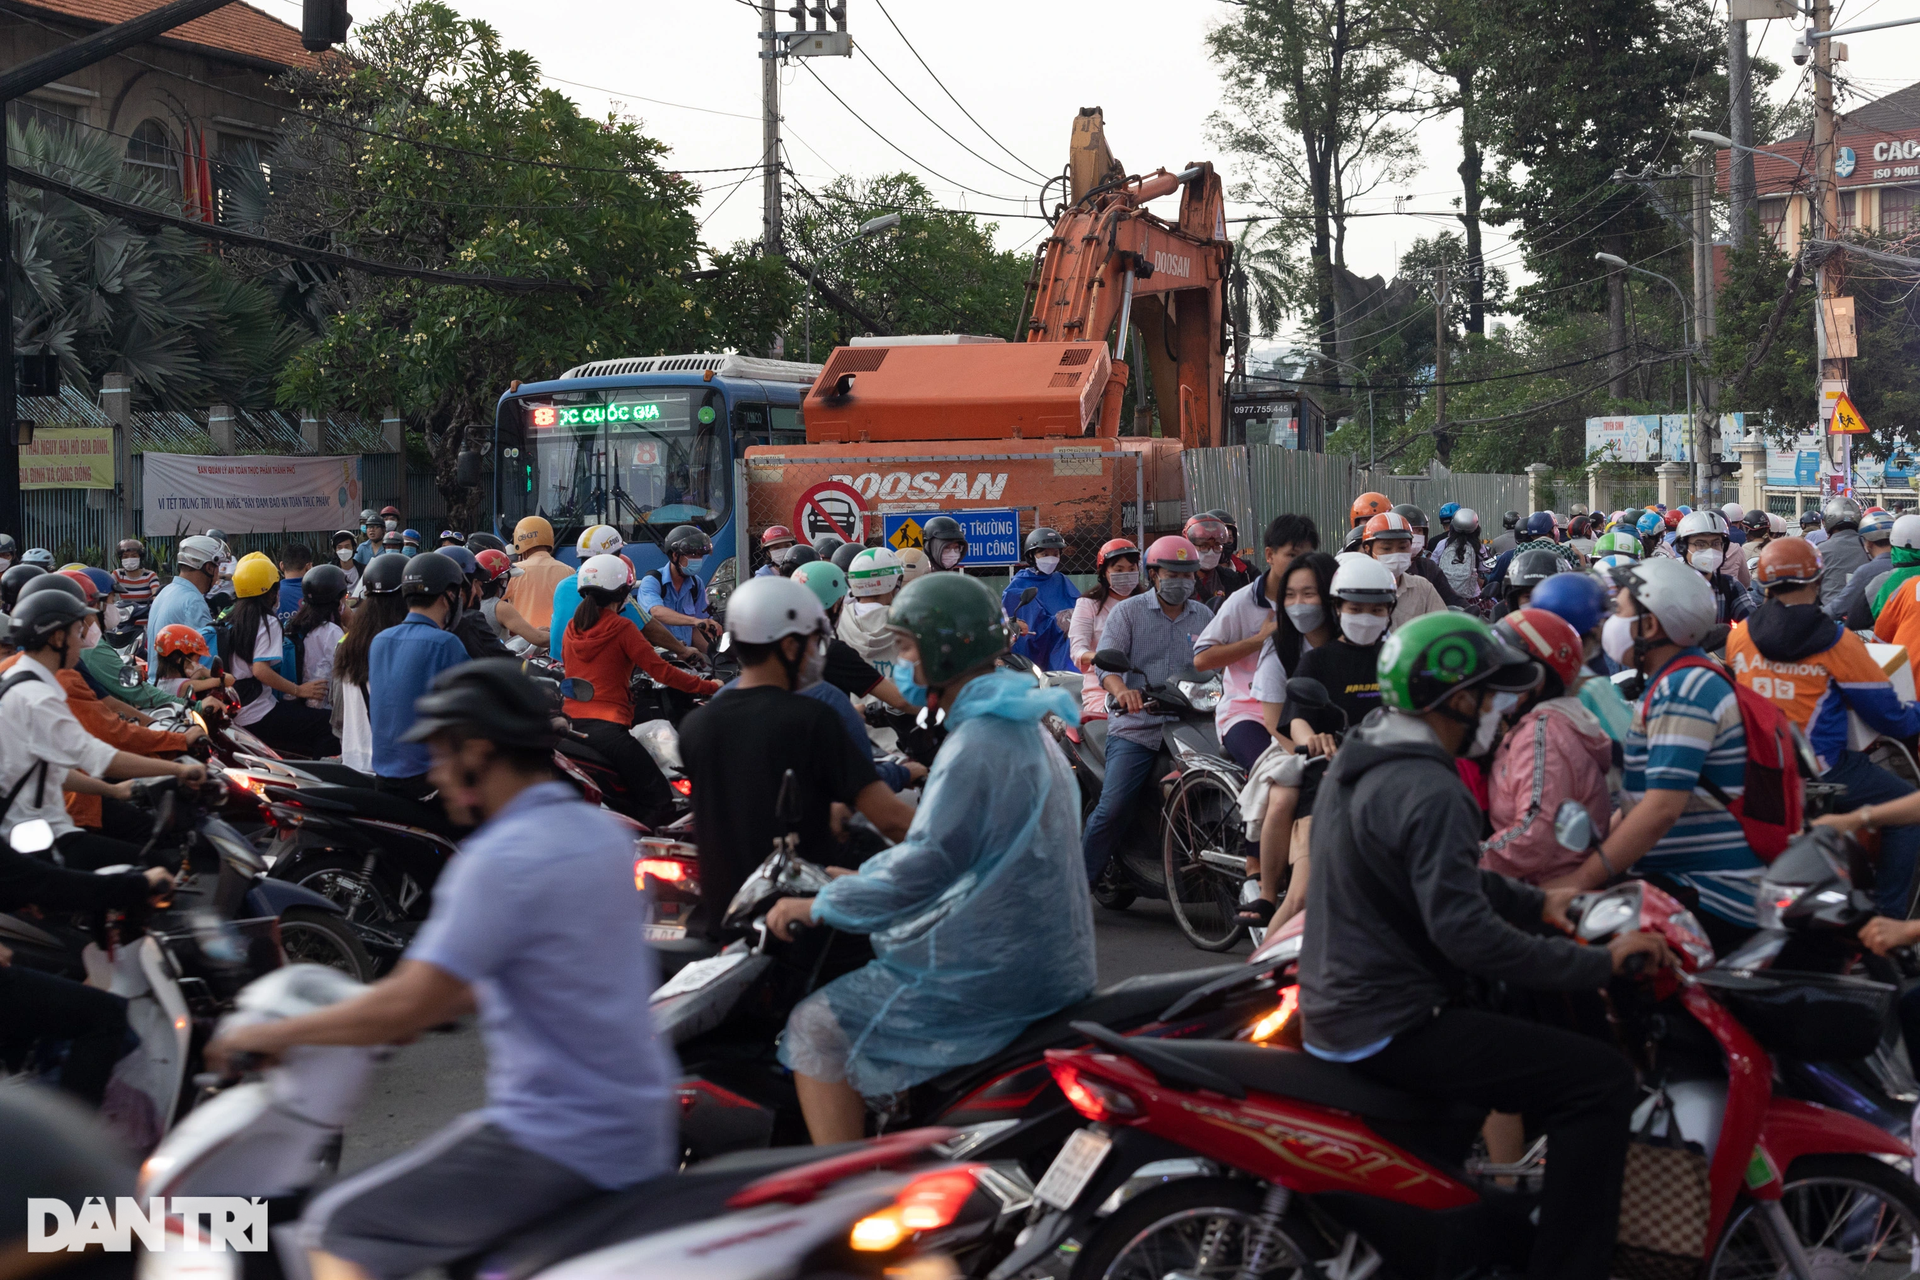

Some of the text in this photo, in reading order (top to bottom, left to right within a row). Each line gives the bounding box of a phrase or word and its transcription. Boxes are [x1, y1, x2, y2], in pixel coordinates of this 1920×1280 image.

[1873, 168, 1891, 179] ISO
[1154, 251, 1190, 278] DOOSAN
[534, 407, 555, 426] 8
[583, 403, 629, 423] QUỐC
[633, 404, 660, 420] GIA
[1234, 405, 1289, 414] 0977.755.445
[80, 439, 92, 455] GIA
[637, 442, 657, 464] 8
[197, 466, 208, 474] BAN
[228, 466, 235, 474] AN
[166, 493, 177, 510] TẾT
[179, 497, 199, 510] TRUNG
[200, 497, 213, 510] THU
[281, 497, 289, 508] AN
[969, 518, 1013, 536] TRƯỜNG
[967, 540, 1015, 557] THI CÔNG
